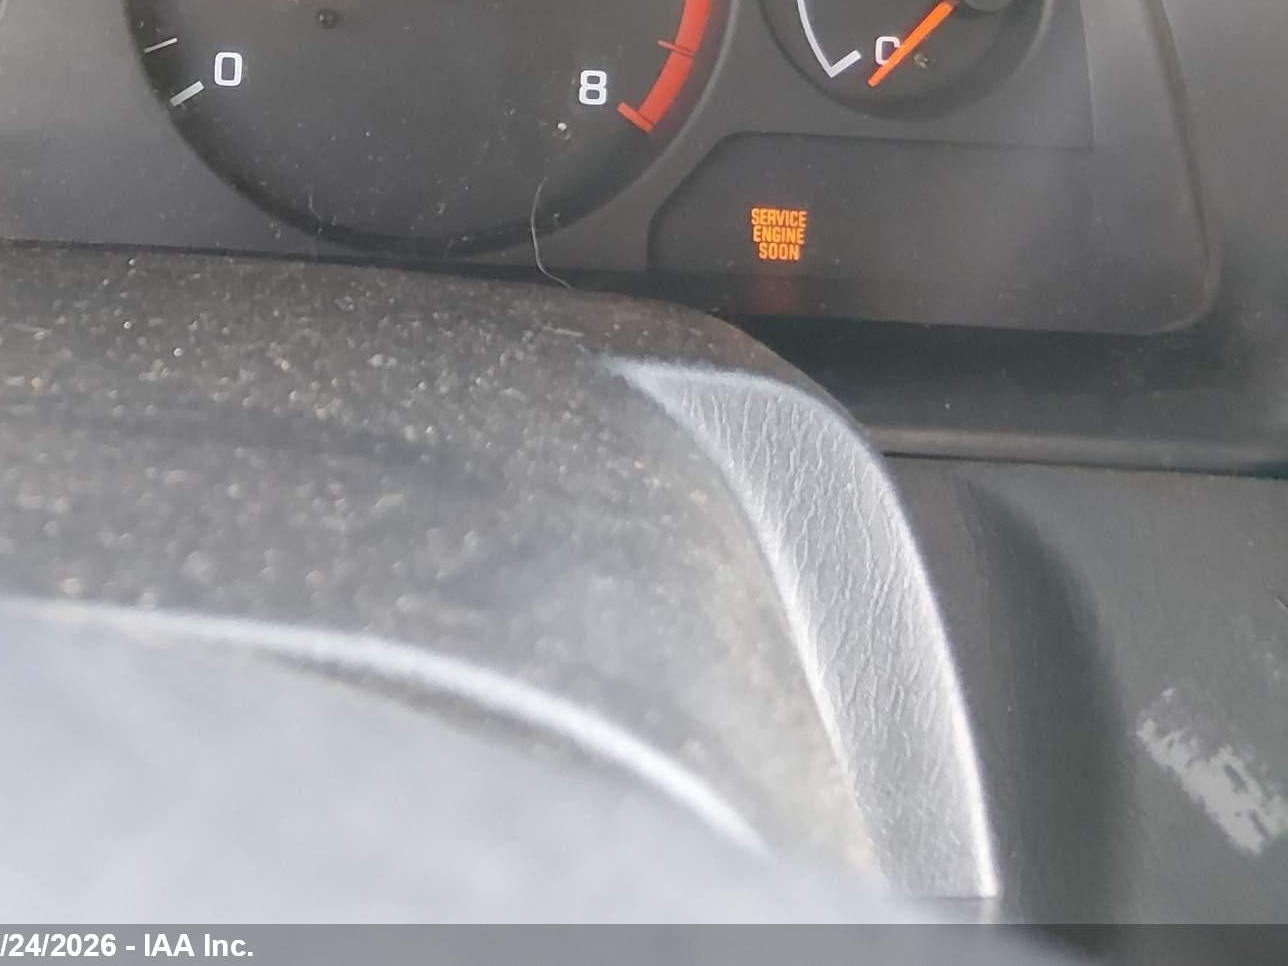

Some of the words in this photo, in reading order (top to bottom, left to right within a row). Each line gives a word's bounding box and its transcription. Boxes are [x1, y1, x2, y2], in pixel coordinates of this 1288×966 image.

[875, 36, 900, 65] C
[214, 52, 242, 86] 0
[579, 70, 607, 105] 8
[751, 208, 807, 228] SERVICE
[753, 226, 805, 245] ENGINE
[759, 243, 800, 261] SOON
